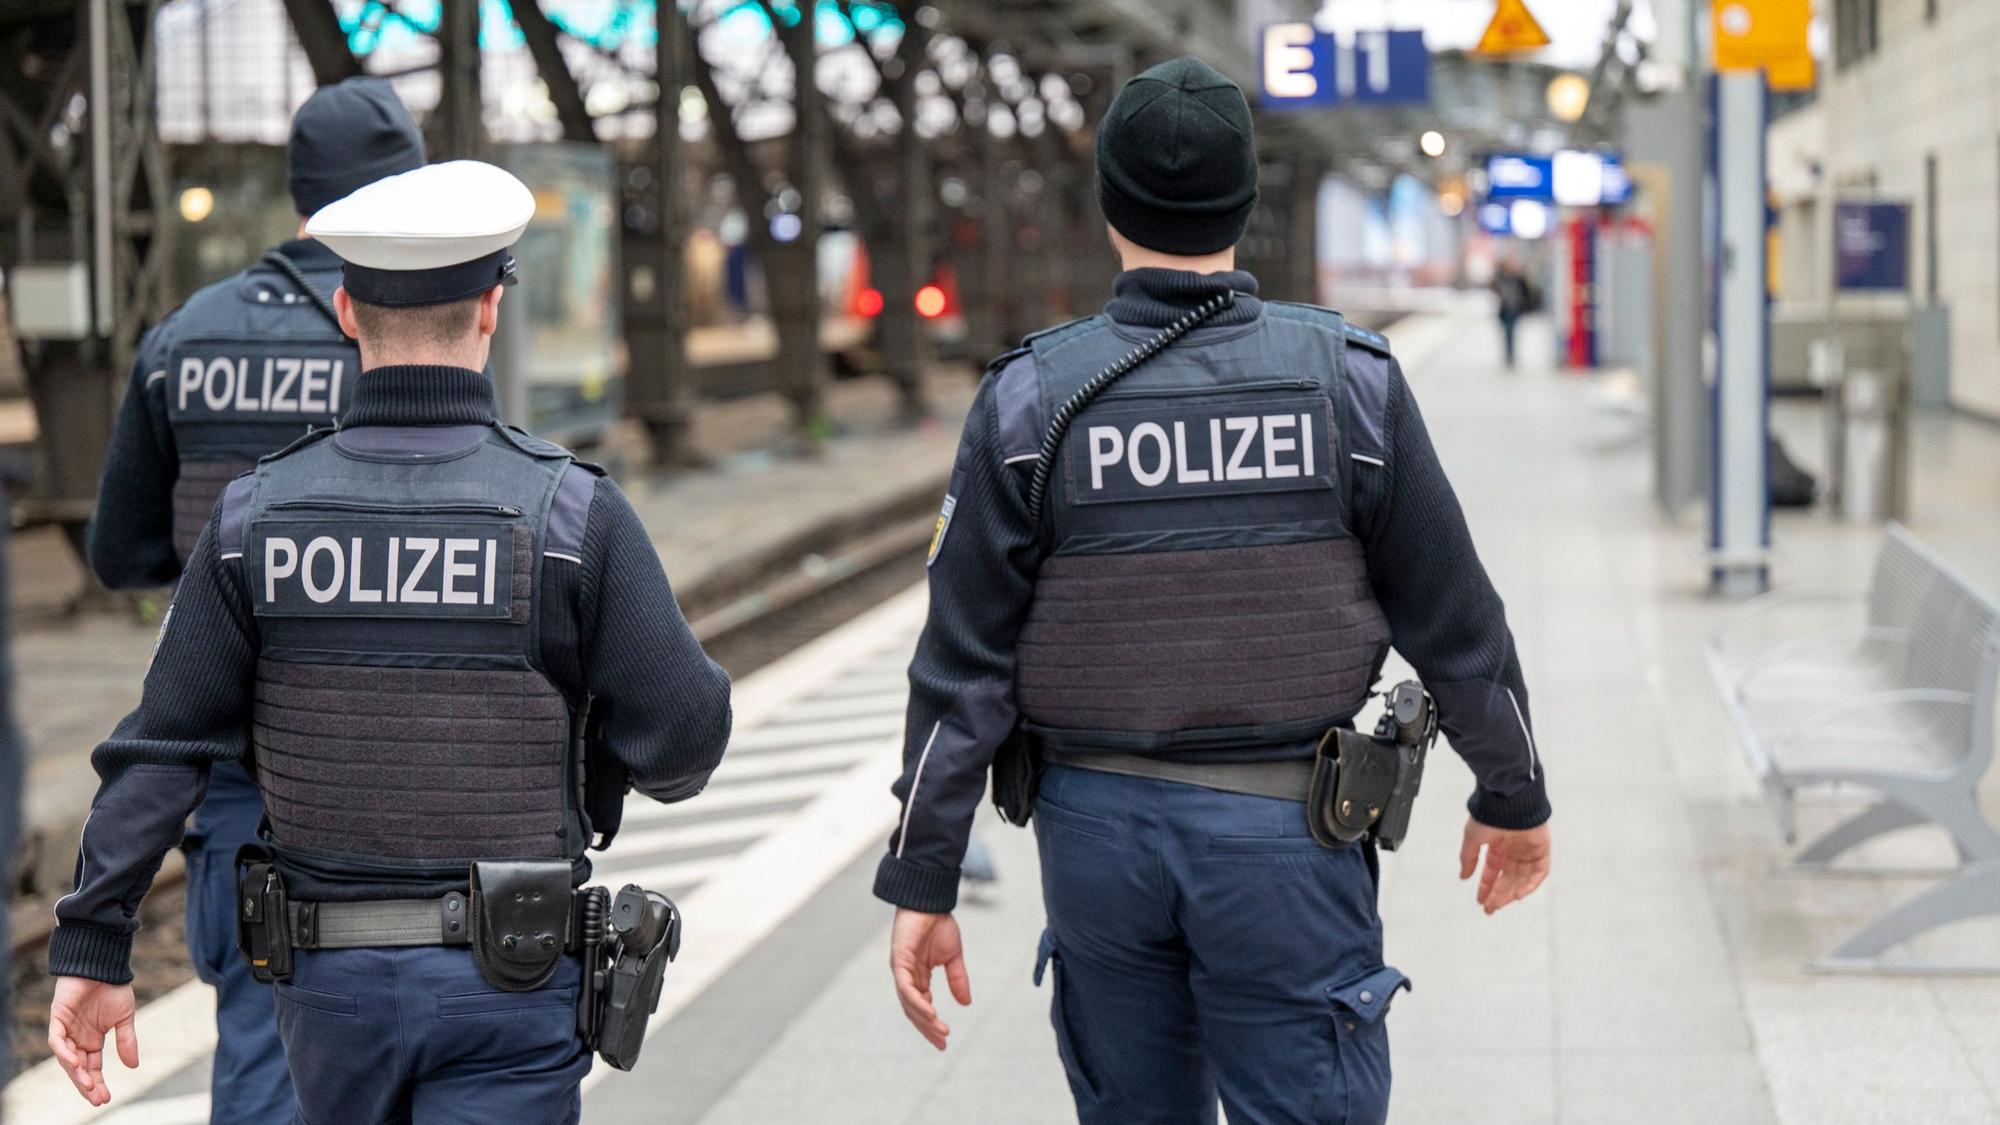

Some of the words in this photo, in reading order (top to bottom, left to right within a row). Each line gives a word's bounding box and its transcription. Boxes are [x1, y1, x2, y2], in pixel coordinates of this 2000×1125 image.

[1264, 22, 1317, 98] E
[178, 356, 344, 413] POLIZEI
[1089, 413, 1315, 490] POLIZEI
[265, 536, 497, 605] POLIZEI
